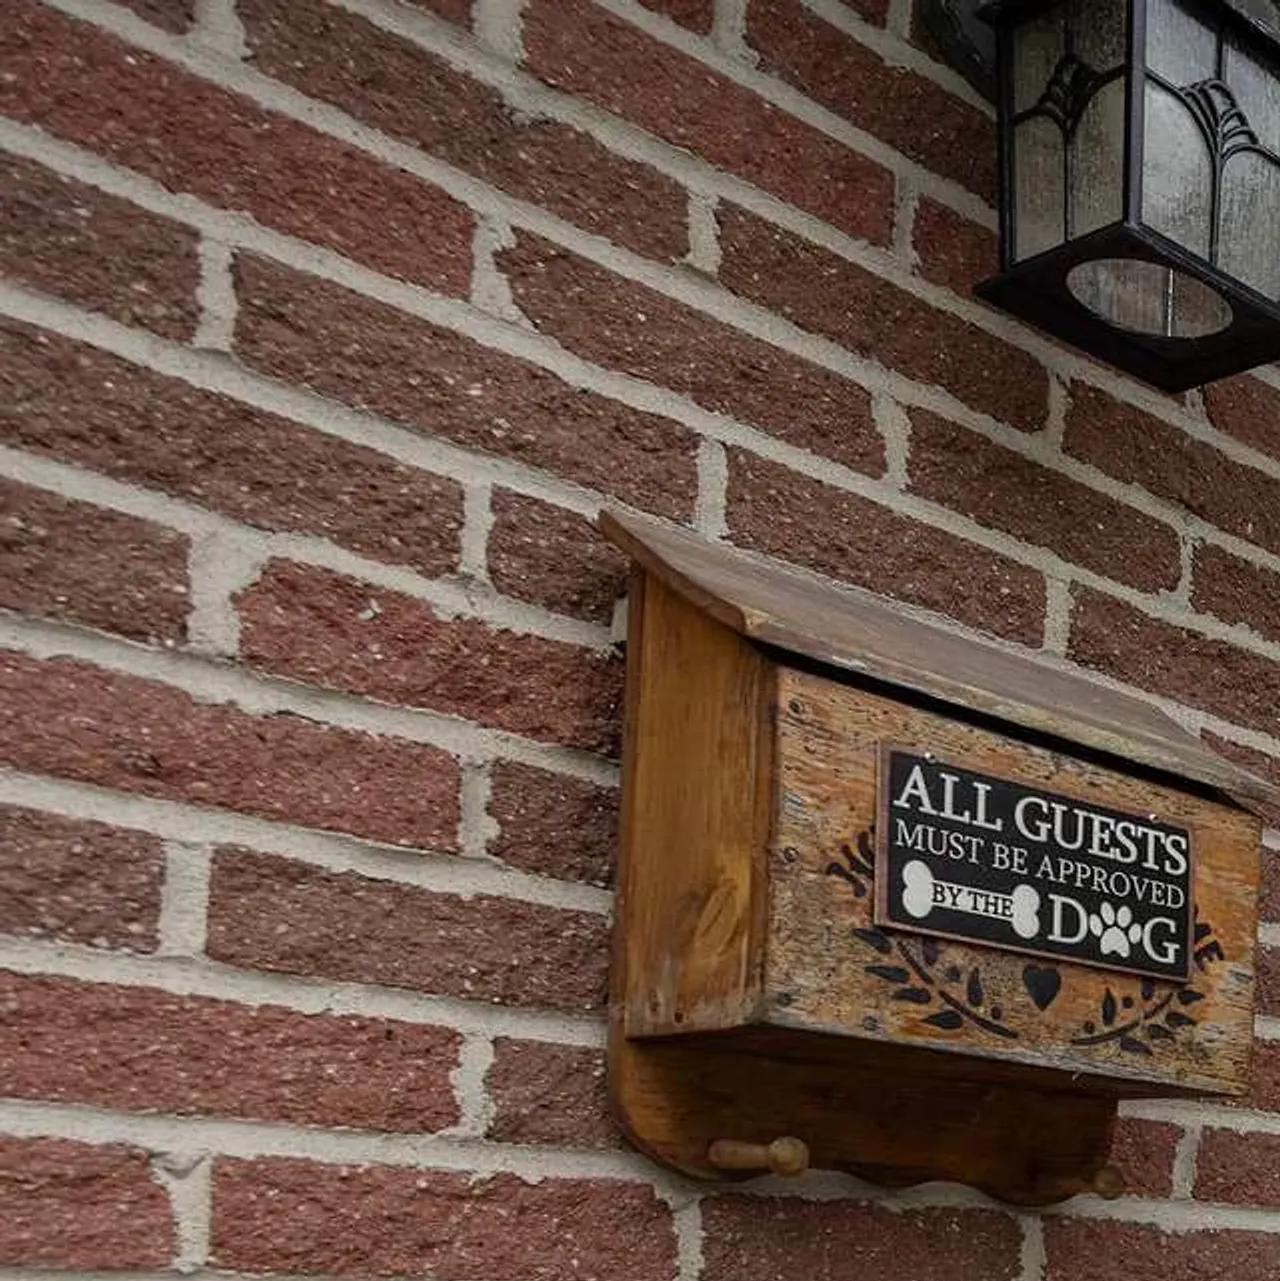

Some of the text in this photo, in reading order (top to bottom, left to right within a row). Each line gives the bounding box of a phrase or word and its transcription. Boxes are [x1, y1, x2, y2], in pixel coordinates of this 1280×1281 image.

[894, 764, 1188, 875] ALL GUESTS
[896, 818, 985, 864] MUST
[992, 842, 1028, 875] BE
[1034, 855, 1185, 910] APPROVED
[932, 883, 962, 905] BY
[969, 889, 1014, 917] THE
[1048, 894, 1180, 964] DG
